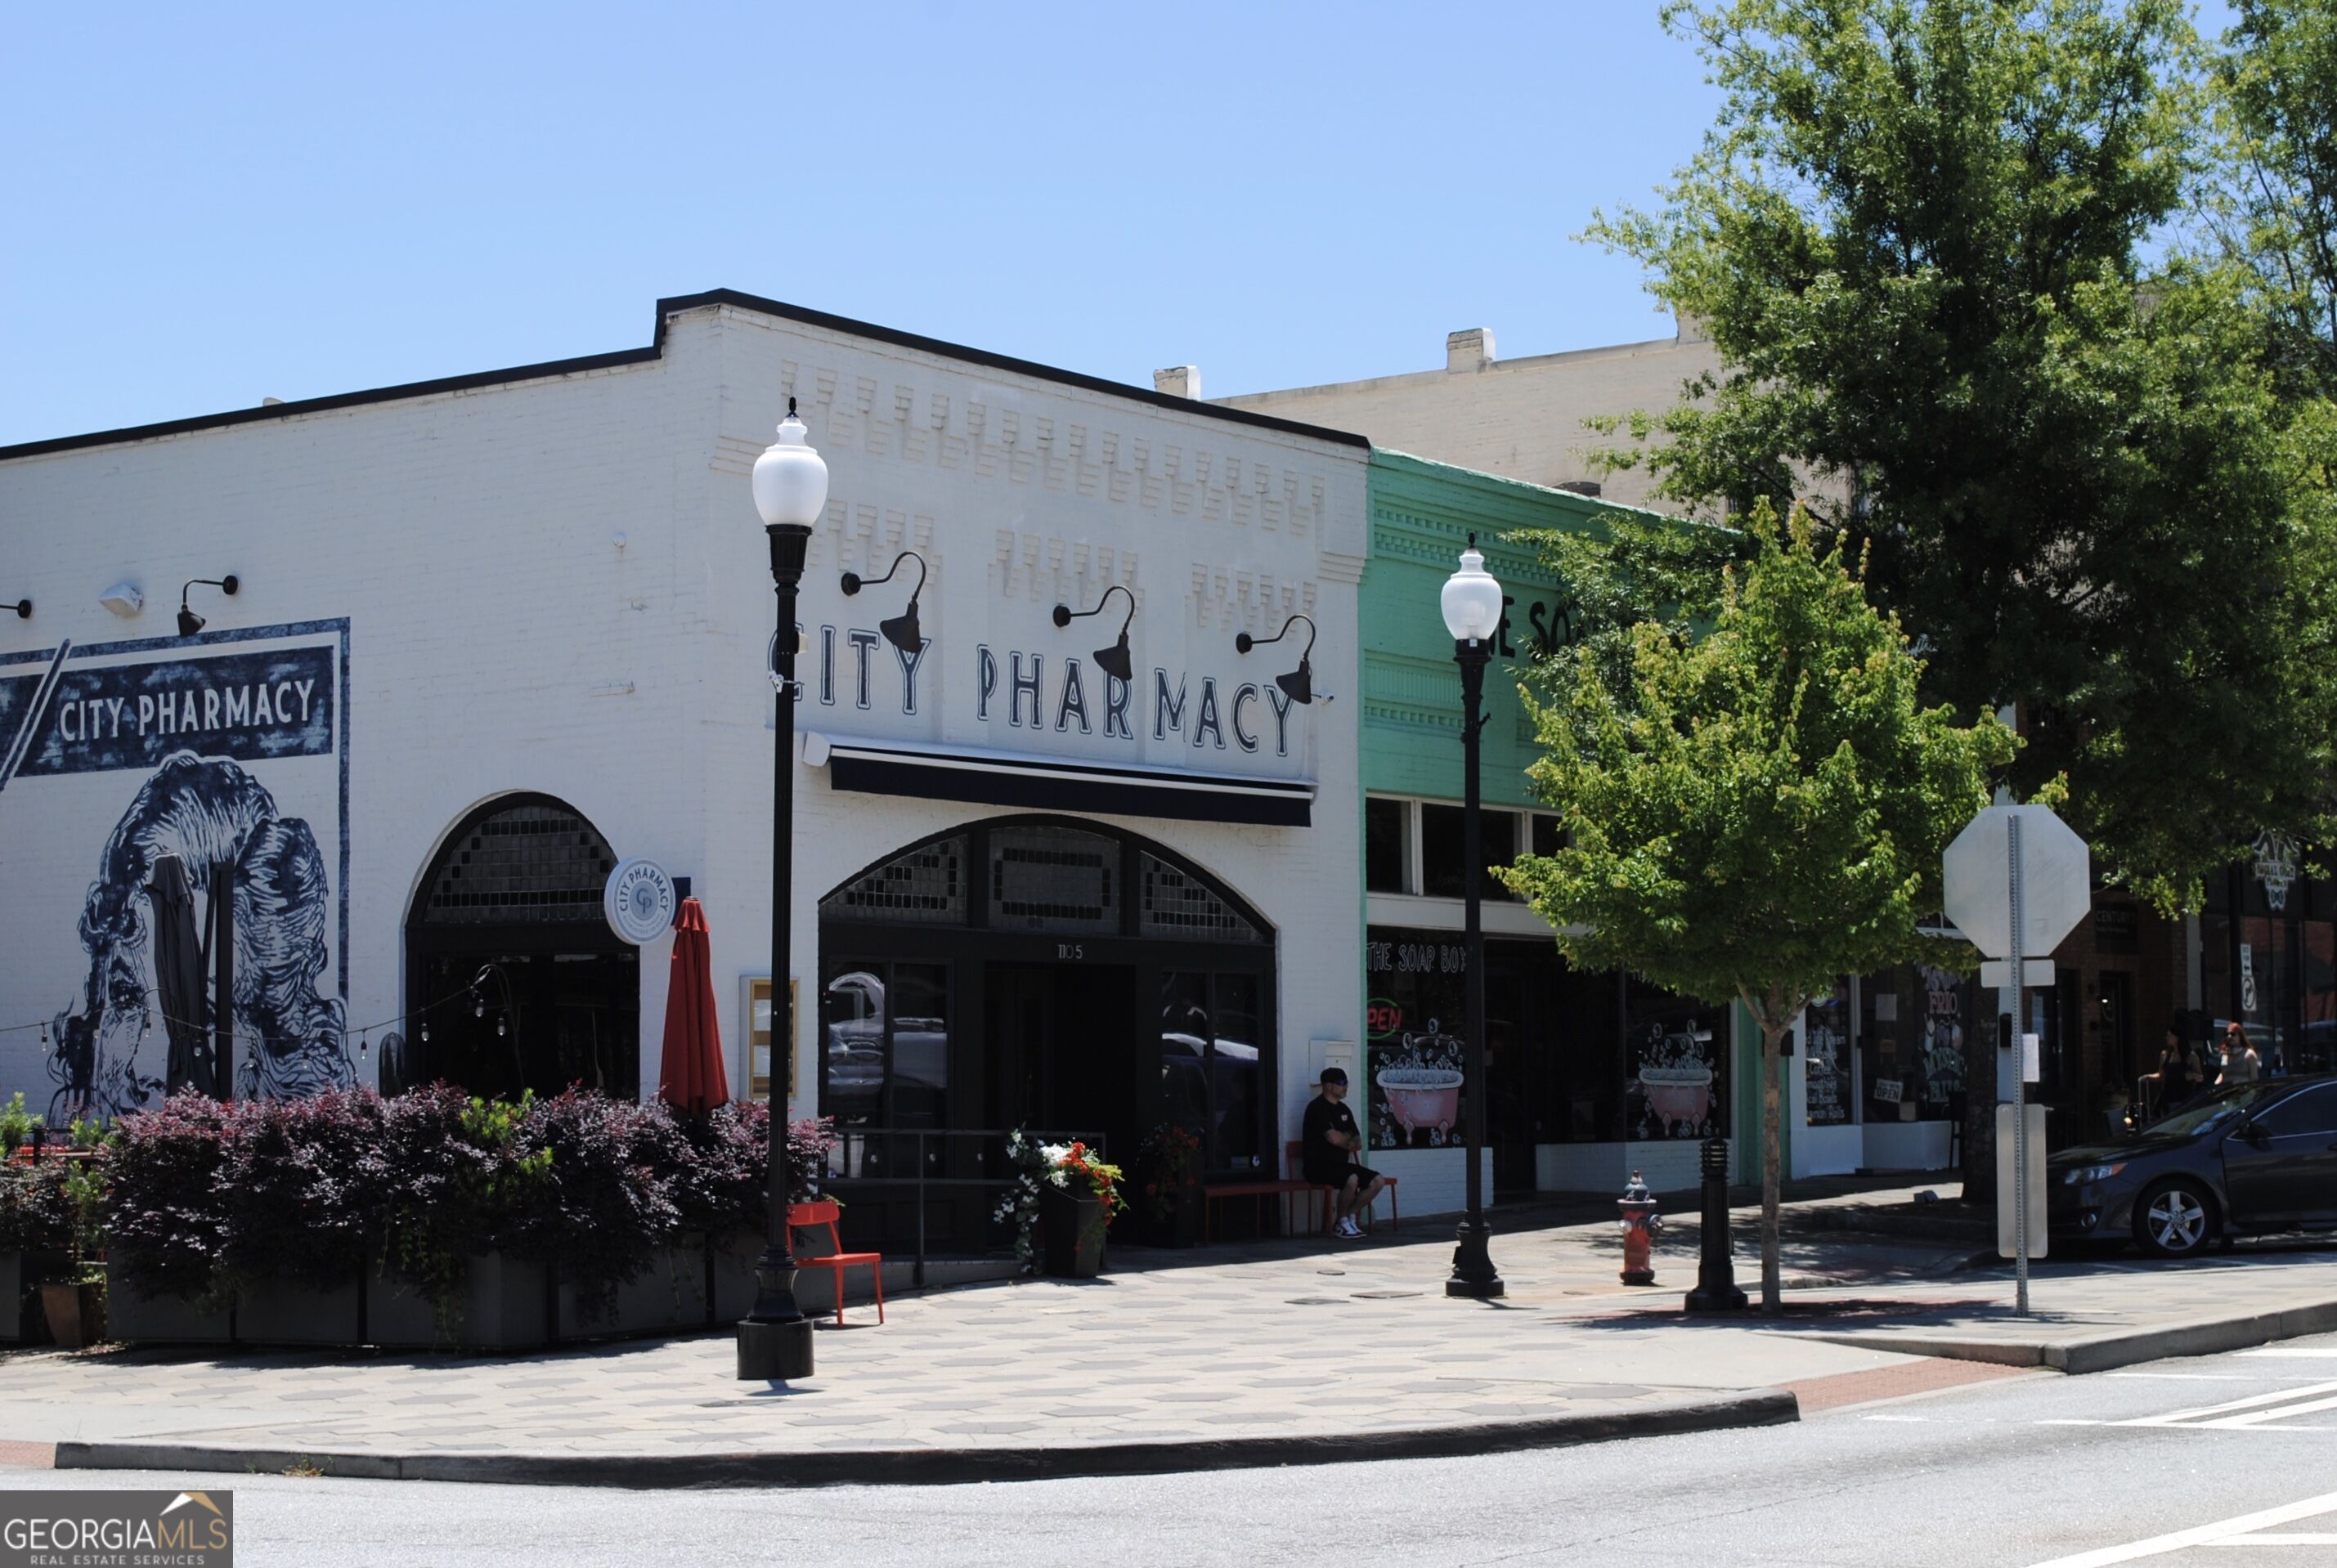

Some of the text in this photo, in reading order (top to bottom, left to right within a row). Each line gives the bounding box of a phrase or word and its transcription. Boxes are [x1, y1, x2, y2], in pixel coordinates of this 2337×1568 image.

[60, 679, 316, 741] CITY PHARMACY
[976, 643, 1296, 757] PHARMACY
[619, 867, 669, 912] CITY PHARMACY
[1057, 943, 1083, 960] 1105
[1366, 941, 1393, 972] THE
[1398, 943, 1436, 973] SOAP
[1367, 1006, 1402, 1031] PEN
[1877, 1086, 1899, 1100] OPEN
